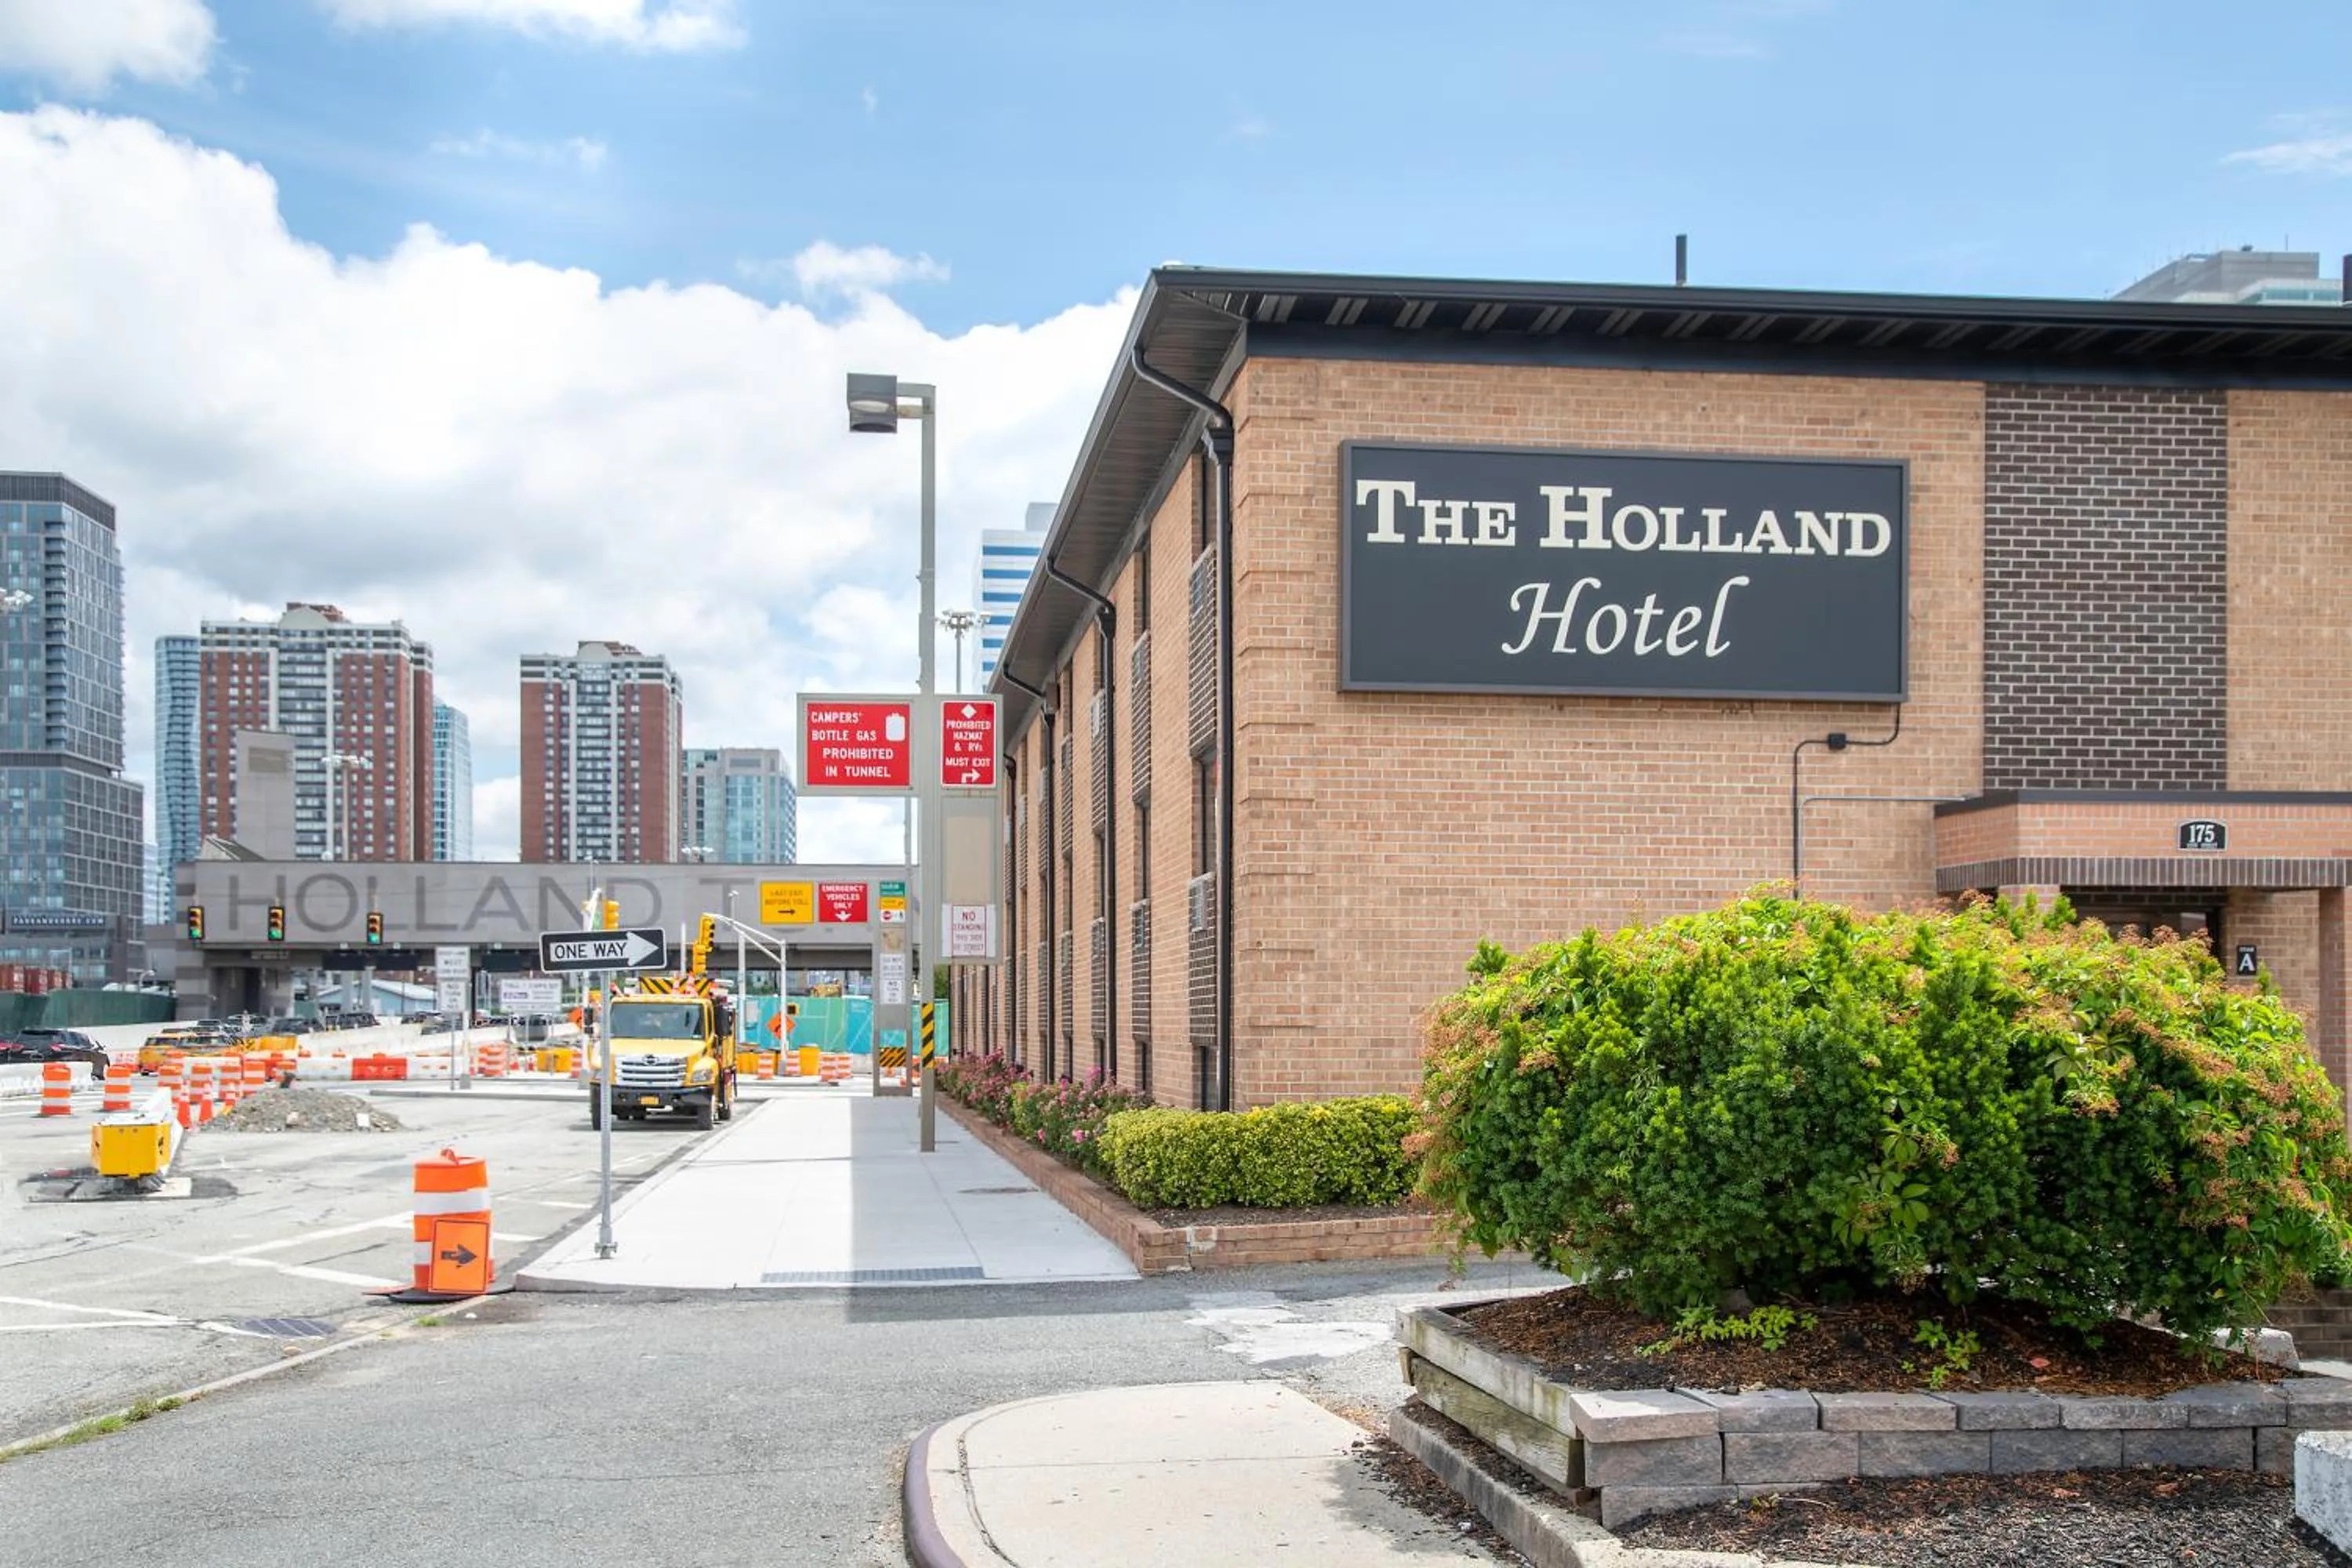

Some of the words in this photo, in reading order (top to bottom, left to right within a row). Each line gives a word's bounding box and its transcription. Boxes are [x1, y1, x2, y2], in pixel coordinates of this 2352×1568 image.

[1356, 479, 1516, 547] THE
[1539, 485, 1891, 557] HOLLAND
[1501, 576, 1751, 657] Hotel
[811, 711, 862, 723] CAMPERS'
[946, 720, 991, 730] PROHIBITED
[811, 730, 849, 741] BOTTLE
[856, 730, 877, 741] GAS
[953, 731, 983, 741] HAZMAT
[954, 742, 962, 752] &
[822, 748, 894, 760] PROHIBITED
[946, 757, 968, 767] MUST
[972, 757, 992, 768] EXIT
[826, 765, 838, 777] IN
[844, 766, 891, 778] TUNNEL
[2189, 824, 2216, 844] 175
[822, 884, 865, 893] EMERGENCY
[228, 873, 662, 933] HOLLAND
[962, 911, 976, 921] NO
[554, 944, 588, 959] ONE
[593, 942, 627, 957] WAY
[2238, 953, 2256, 971] A
